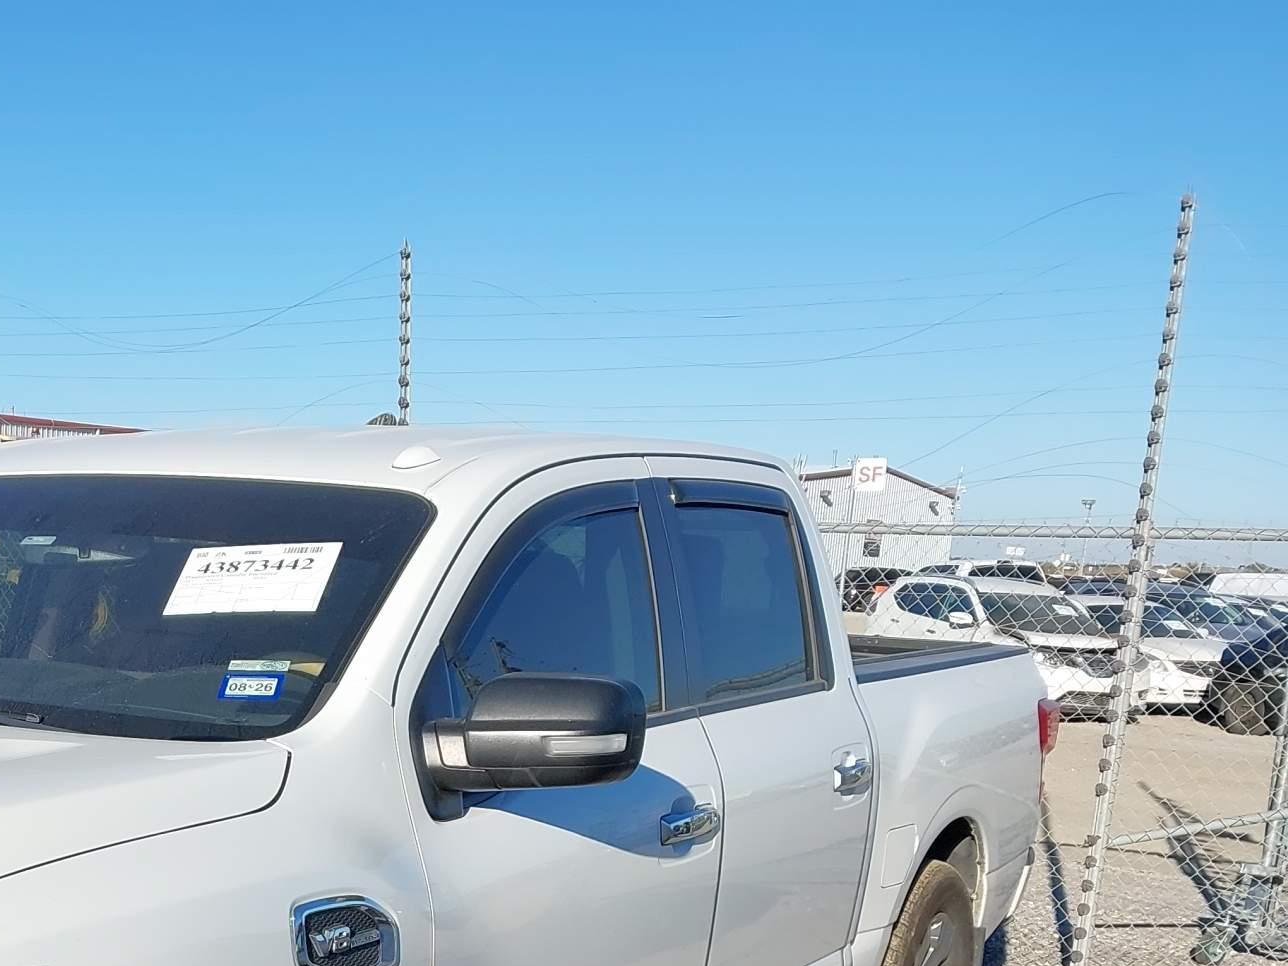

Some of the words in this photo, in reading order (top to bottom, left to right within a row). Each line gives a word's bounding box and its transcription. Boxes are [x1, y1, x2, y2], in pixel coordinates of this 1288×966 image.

[858, 465, 884, 483] SF
[197, 557, 316, 574] 43873442
[309, 925, 352, 957] V8
